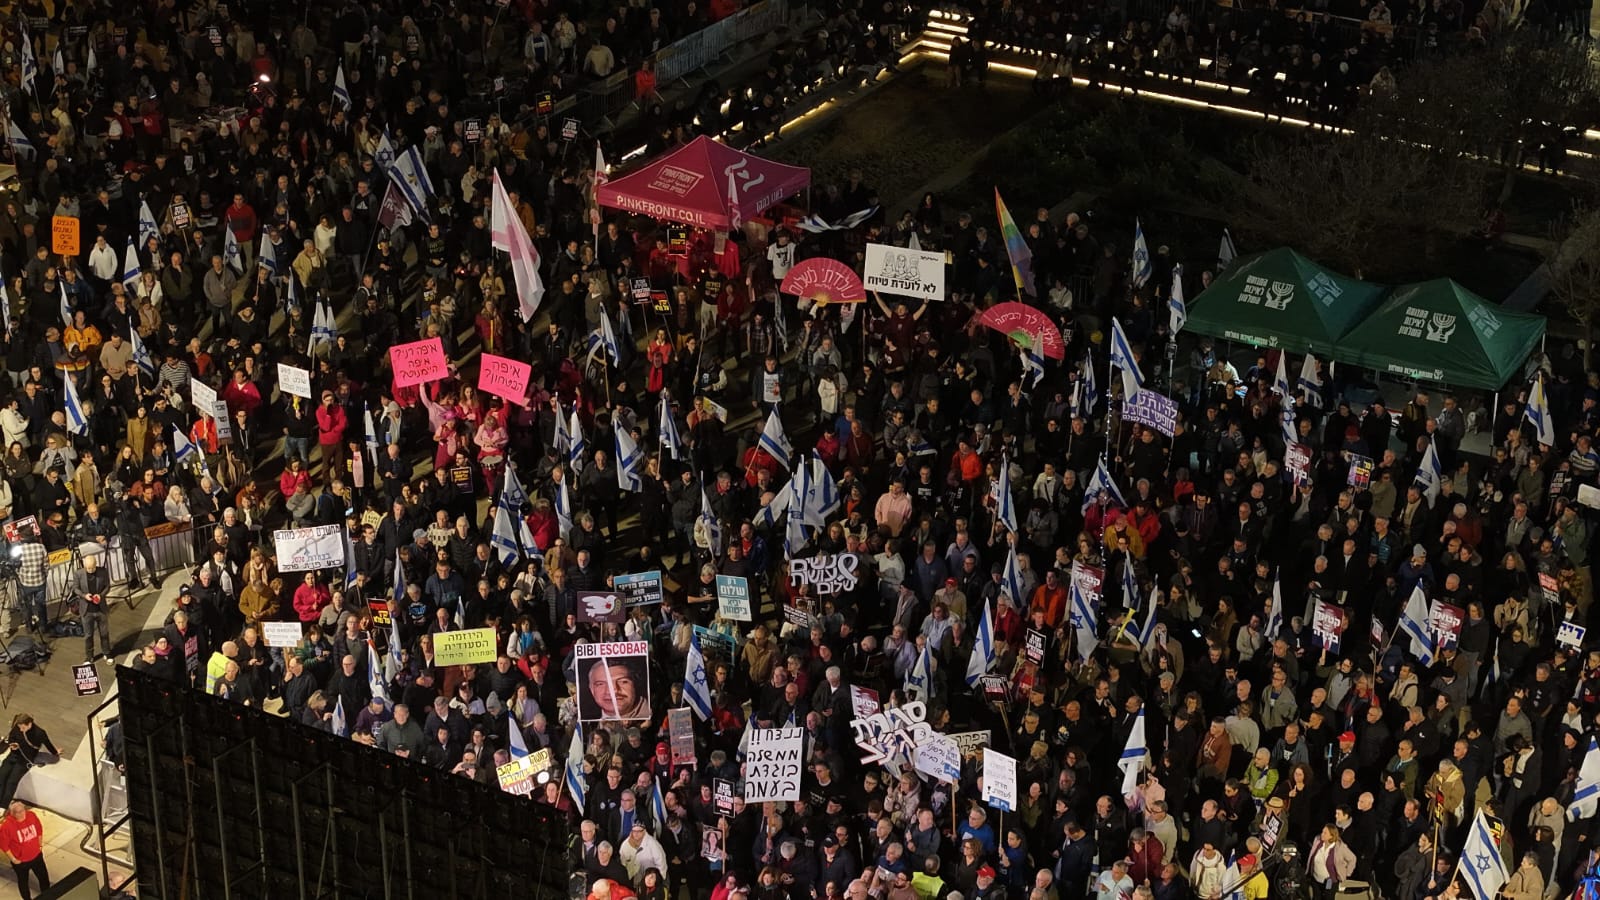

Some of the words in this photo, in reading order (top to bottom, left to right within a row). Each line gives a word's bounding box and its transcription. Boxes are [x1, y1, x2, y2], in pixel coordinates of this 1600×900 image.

[616, 194, 706, 225] PINKFRONT.CO.IL
[788, 266, 817, 296] לשלום
[821, 267, 857, 299] נולדתי
[867, 275, 889, 286] טיוח
[890, 278, 920, 292] לועדת
[922, 282, 936, 294] לא
[994, 312, 1021, 325] הביתה
[1024, 313, 1038, 325] לך
[417, 343, 438, 356] איפה
[407, 358, 431, 368] איפה
[491, 360, 521, 378] איפה
[484, 368, 523, 394] הבטחון?
[790, 553, 837, 572] נשים
[727, 578, 736, 586] רק
[790, 567, 837, 587] עושות
[720, 585, 745, 597] שלום
[816, 575, 855, 595] שלום
[448, 631, 483, 642] היוזמה
[444, 640, 489, 651] הסעודית
[576, 645, 597, 656] BIBI
[600, 642, 647, 656] ESCOBAR
[437, 652, 464, 660] היחידי
[468, 649, 496, 658] הפתרון
[956, 732, 989, 744] הפקיר
[748, 749, 798, 762] ממשלה
[749, 763, 799, 778] בוגדת
[746, 779, 796, 799] בעמה
